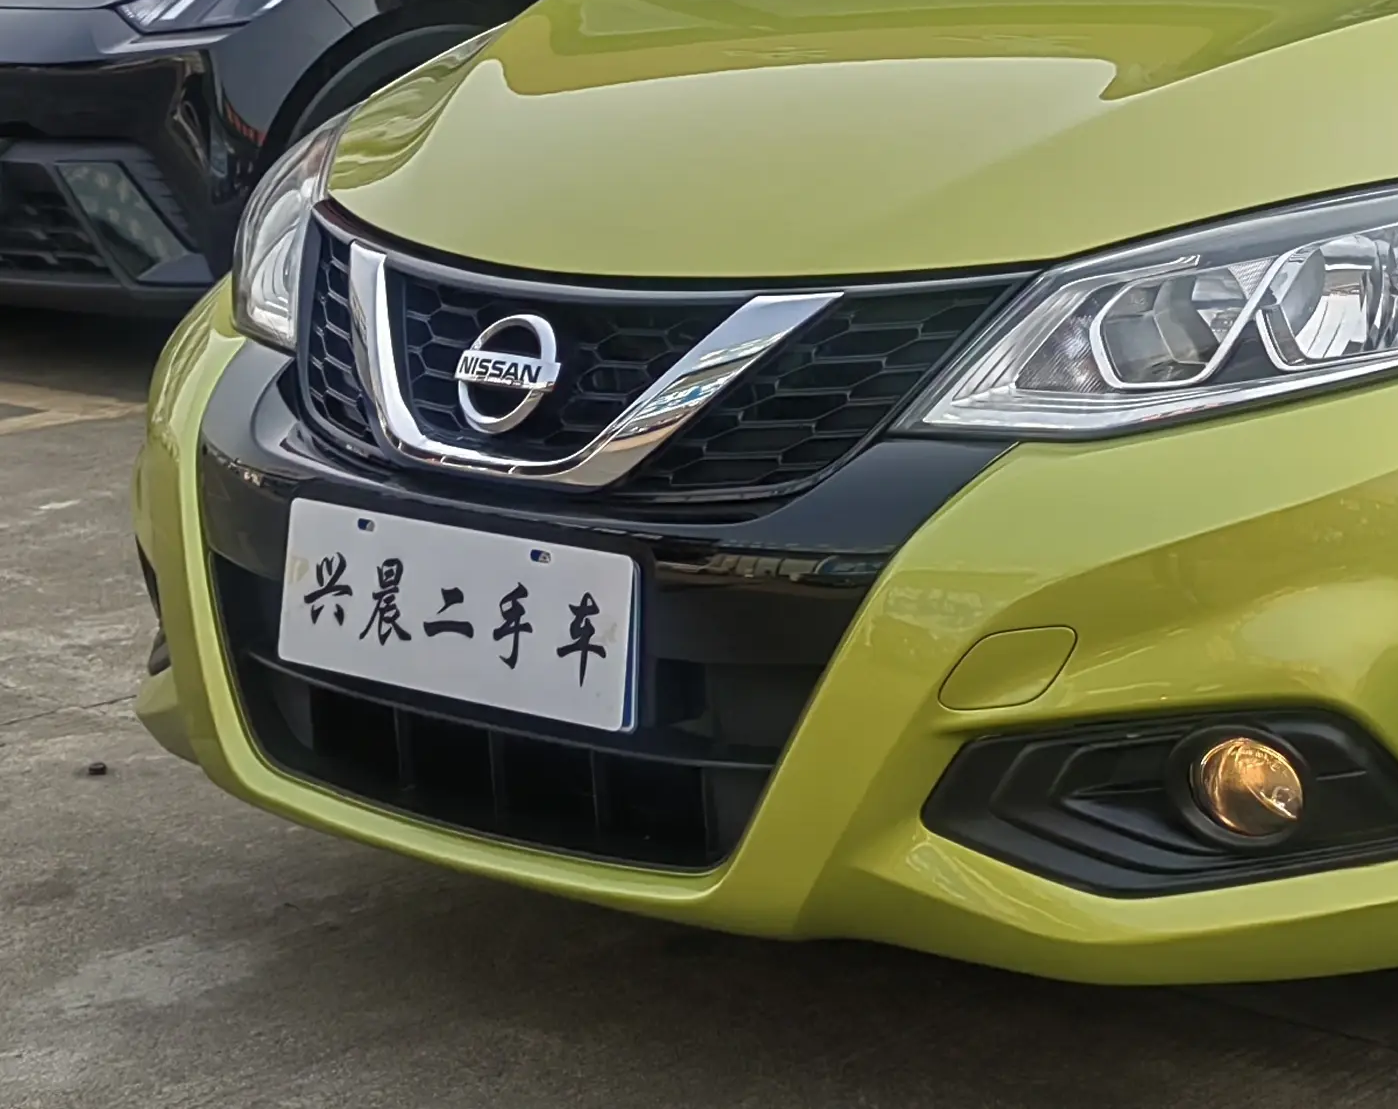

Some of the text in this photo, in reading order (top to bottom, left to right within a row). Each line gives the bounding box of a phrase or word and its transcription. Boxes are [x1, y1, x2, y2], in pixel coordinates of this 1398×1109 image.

[459, 356, 543, 384] NISSAN
[303, 552, 607, 688] 兴晨二手车
